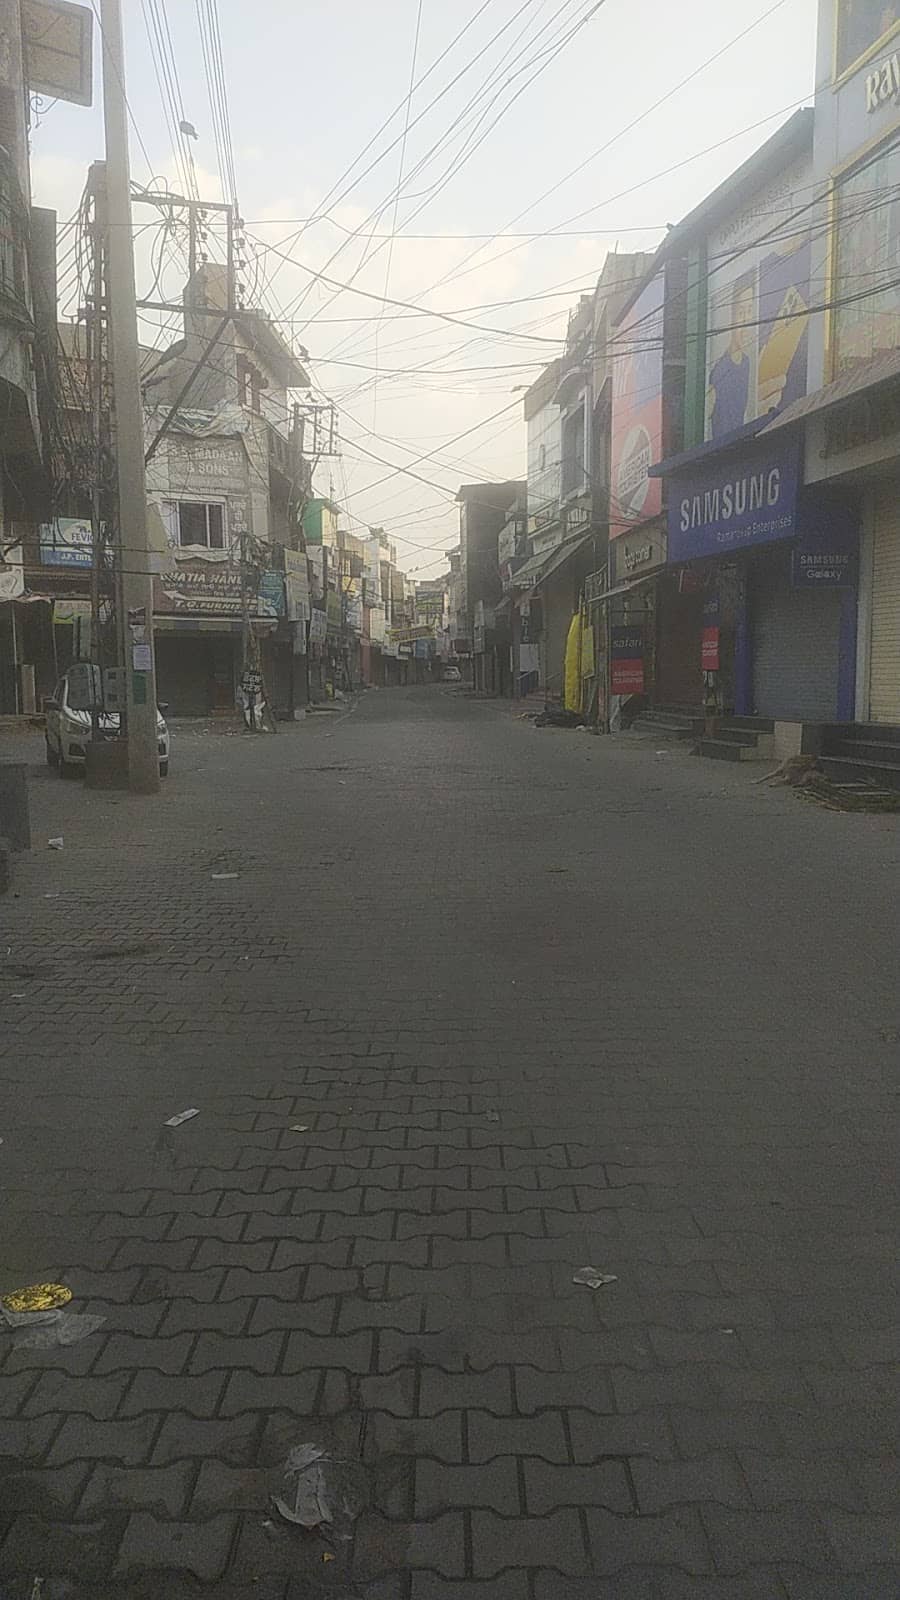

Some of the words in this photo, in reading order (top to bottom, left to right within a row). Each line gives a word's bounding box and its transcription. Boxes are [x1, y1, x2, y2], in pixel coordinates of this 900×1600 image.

[198, 461, 230, 476] SONS
[680, 467, 781, 532] SAMSUNG
[800, 555, 849, 564] SAMSUNG
[806, 569, 842, 581] Galaxy
